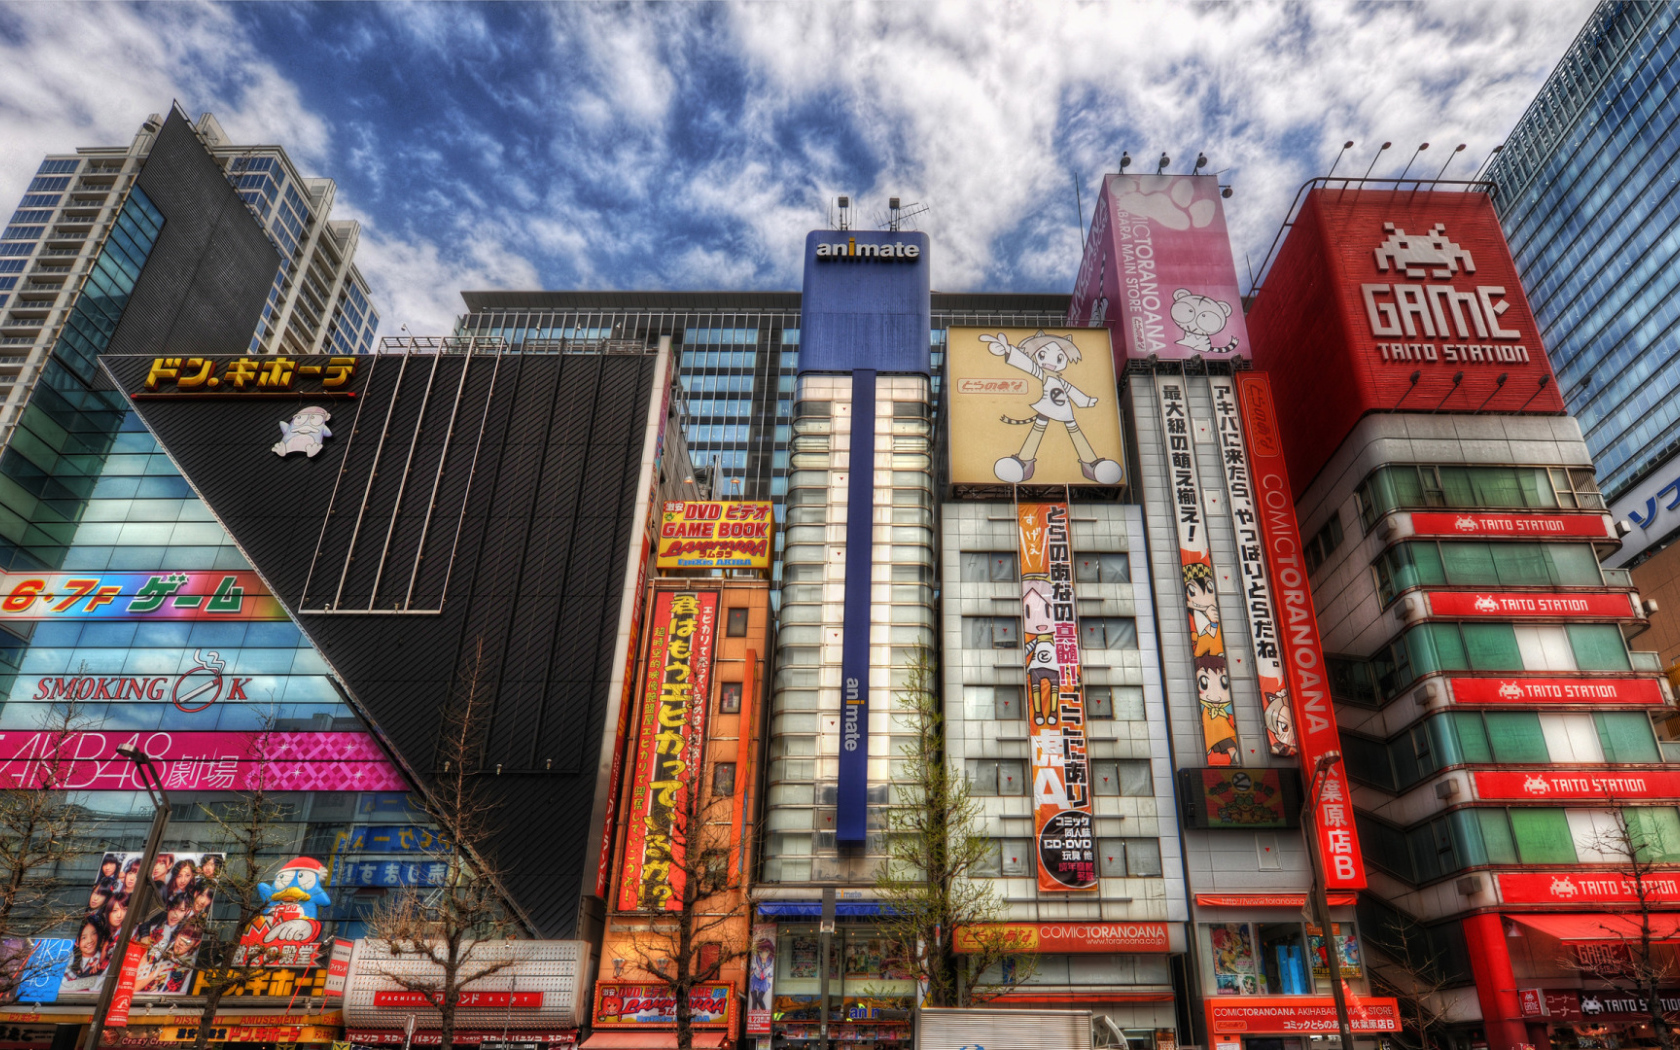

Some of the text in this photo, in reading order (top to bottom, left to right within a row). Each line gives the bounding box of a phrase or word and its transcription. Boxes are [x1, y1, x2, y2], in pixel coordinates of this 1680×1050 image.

[816, 237, 920, 258] animate
[1121, 243, 1137, 275] MAIN
[1125, 277, 1142, 313] STORE
[1361, 283, 1521, 339] GAME
[1377, 343, 1530, 363] TAITO STATION
[1163, 385, 1200, 542] 最大級の萌え揃え!
[684, 504, 721, 520] DVD
[725, 504, 770, 520] ビデオ
[662, 522, 768, 538] GAME BOOK
[1480, 519, 1564, 531] TAITO STATION
[1023, 513, 1041, 556] すげえ
[125, 574, 243, 613] ゲーム
[1262, 474, 1330, 735] COMICTORANOANA
[1500, 600, 1588, 611] TAITO STATION
[33, 677, 168, 700] SMOKING
[1525, 685, 1617, 697] TAITO STATION
[844, 677, 865, 752] animate
[1551, 779, 1646, 792] TAITO STATION
[1056, 817, 1090, 826] コミック
[835, 889, 862, 899] nimate
[1579, 881, 1678, 895] TAITO STATION
[1040, 926, 1165, 939] COMICTORANOANA
[1086, 938, 1166, 946] www.toranoana.co.jp/
[1214, 1007, 1295, 1017] COMICTORANOANA
[1297, 1007, 1337, 1016] AKIHABAR
[1368, 1006, 1393, 1016] STORE
[1605, 1000, 1636, 1012] TAITO
[240, 1015, 304, 1025] AMUSEMENT
[1283, 1020, 1340, 1030] コミックとらのあ
[347, 1034, 379, 1042] パチンコ
[384, 1034, 405, 1042] スロッ
